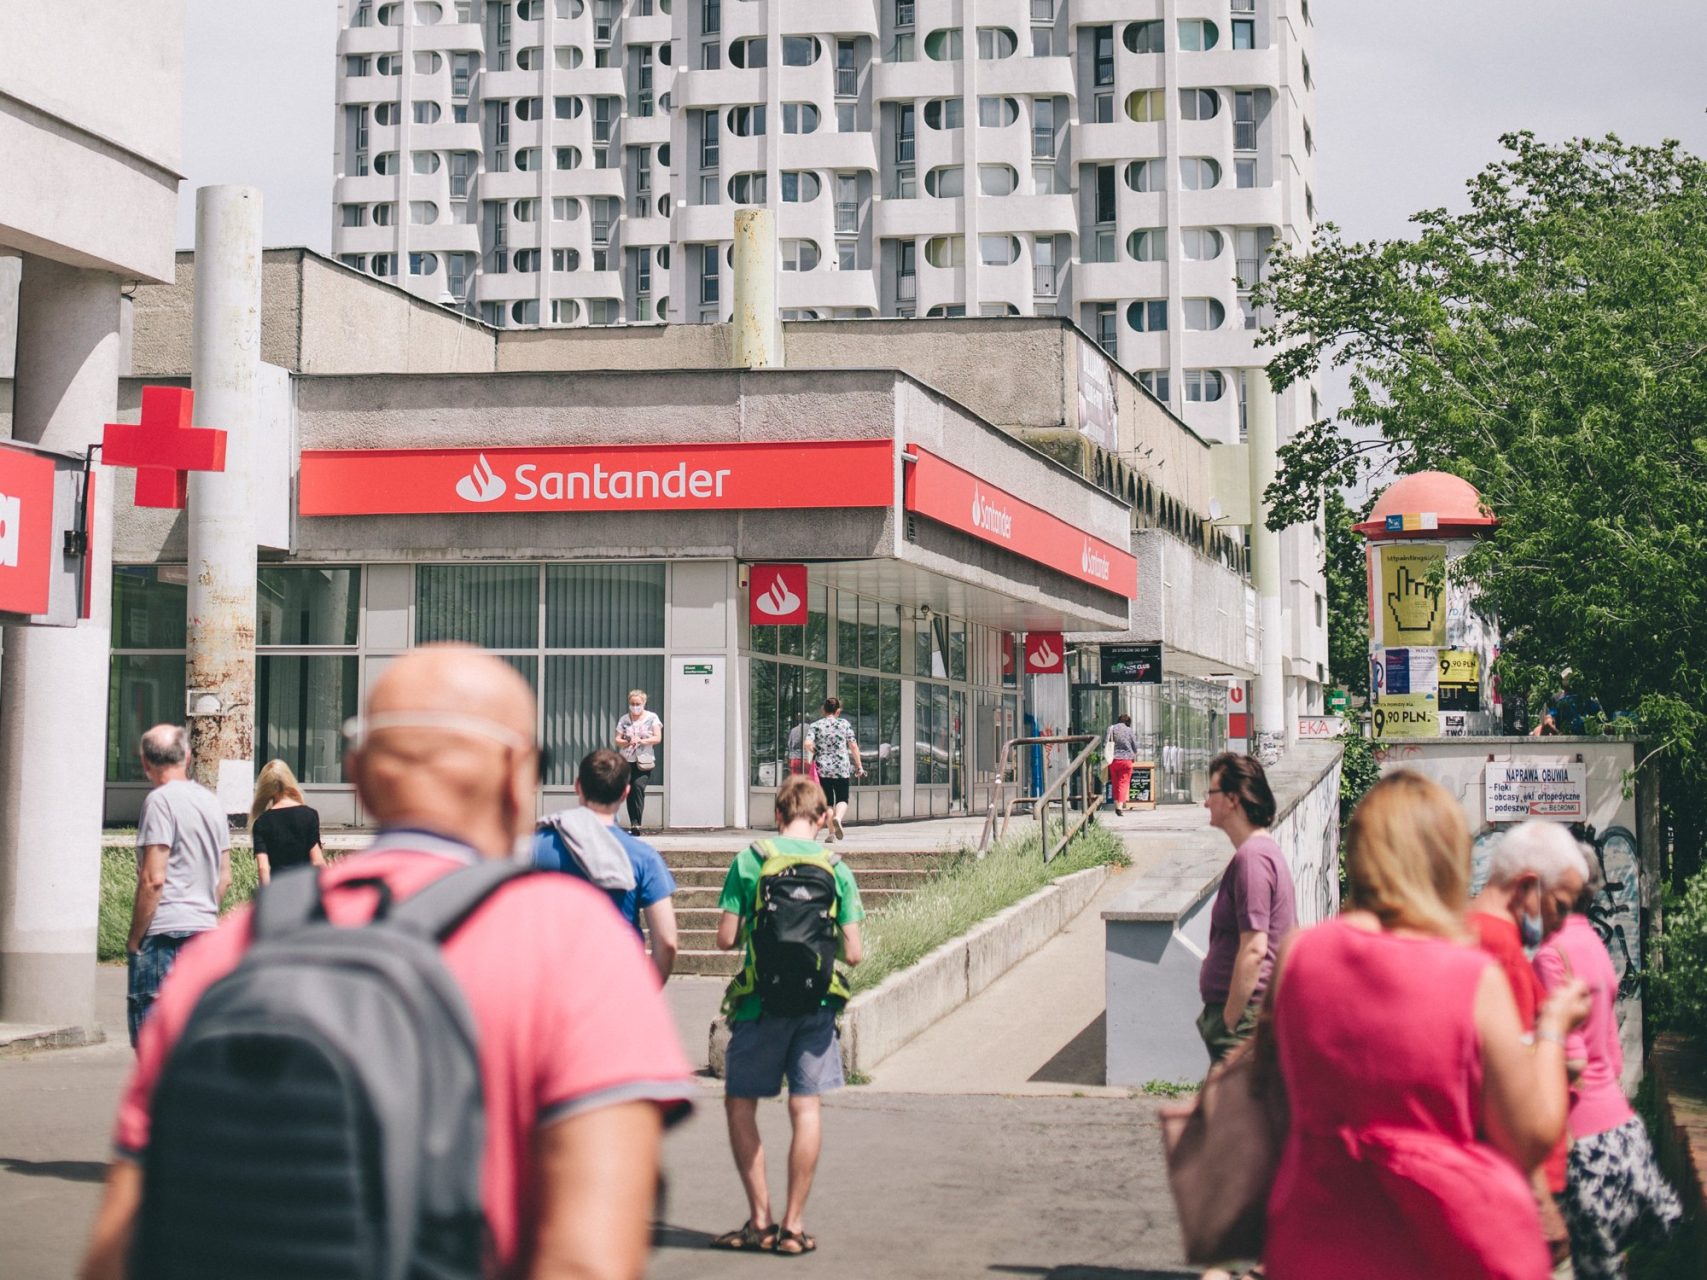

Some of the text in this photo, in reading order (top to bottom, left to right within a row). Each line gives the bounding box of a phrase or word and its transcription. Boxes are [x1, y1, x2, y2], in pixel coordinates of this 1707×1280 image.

[514, 461, 731, 501] Santander
[980, 495, 1012, 539] Santander
[1087, 547, 1110, 581] Santander
[1298, 720, 1330, 735] EKA
[1506, 768, 1569, 782] NAPRAWA OBUWIA
[1493, 793, 1520, 803] obcasy
[1537, 791, 1580, 803] ortopedyczne
[1494, 803, 1530, 814] podeszwy
